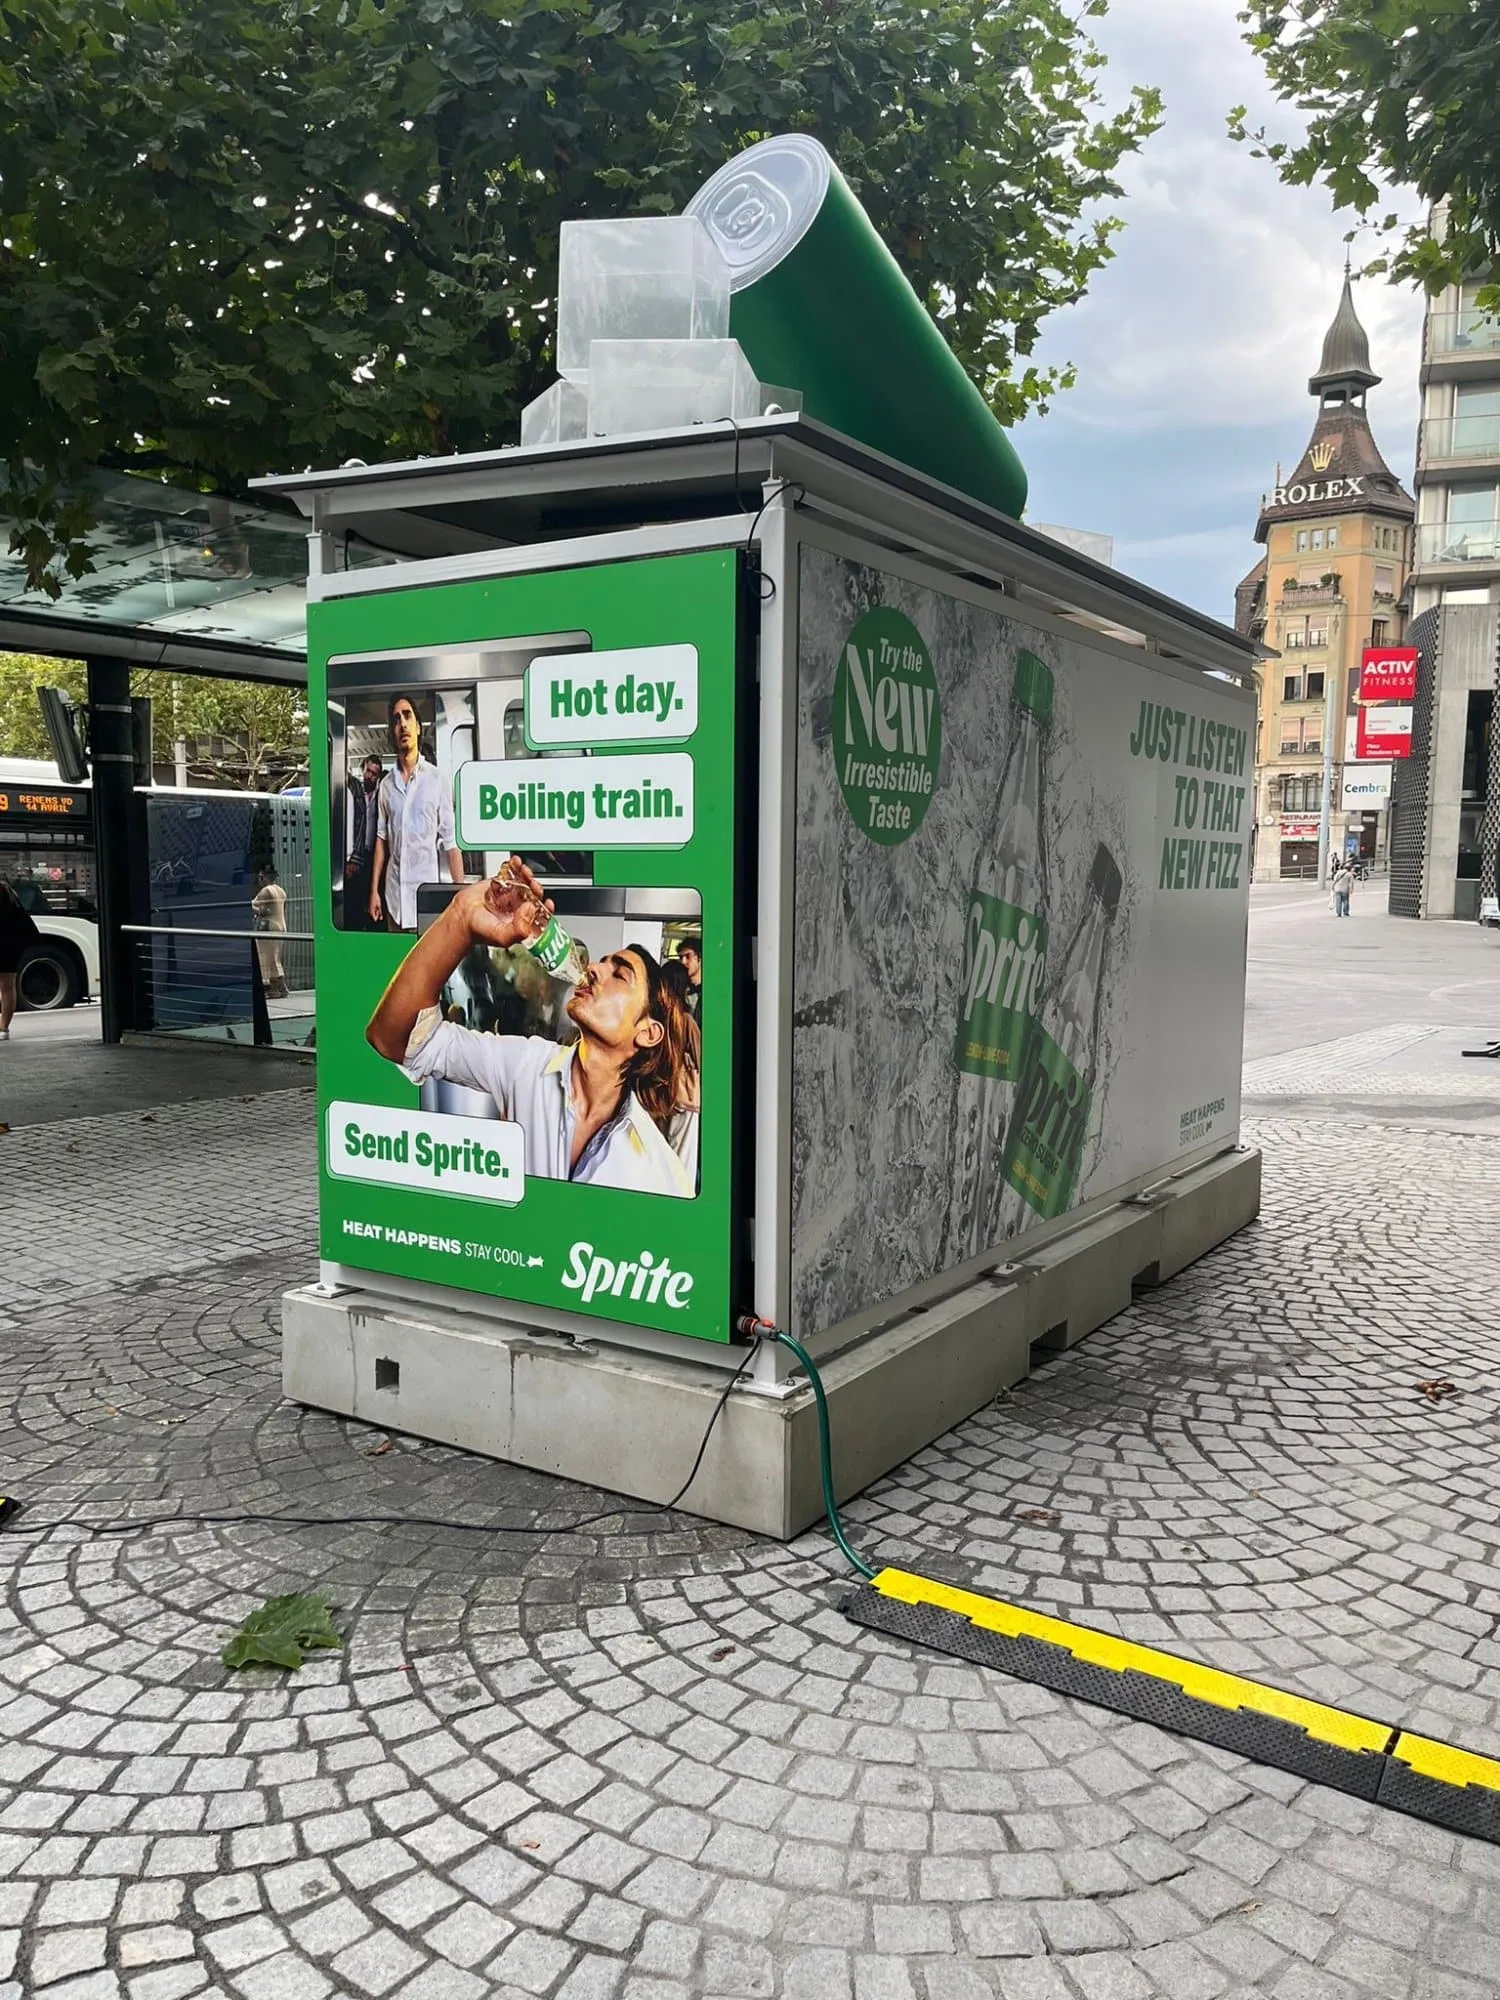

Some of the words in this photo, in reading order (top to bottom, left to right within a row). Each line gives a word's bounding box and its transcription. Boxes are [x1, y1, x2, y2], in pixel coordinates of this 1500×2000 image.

[1271, 477, 1364, 506] ROLEX
[880, 637, 900, 672] Try
[902, 646, 923, 673] the
[1364, 661, 1414, 675] ACTIV
[550, 679, 608, 718] Hot
[615, 675, 683, 722] day.
[845, 643, 934, 756] New
[1362, 677, 1414, 687] FITNESS
[1130, 701, 1186, 763] JUST
[1186, 715, 1247, 776] LISTEN
[844, 753, 933, 795] Irresistible
[1344, 783, 1387, 793] Cembra
[19, 795, 58, 804] RENENS
[41, 804, 69, 812] AVRIL
[479, 783, 585, 829] Boiling
[593, 780, 684, 818] train.
[868, 795, 911, 829] Taste
[1174, 775, 1199, 829] TO
[1202, 780, 1246, 833] THAT
[1159, 837, 1206, 889] NEW
[1206, 841, 1243, 889] FIZZ
[960, 901, 1045, 1022] Sprite
[345, 1122, 409, 1163] Send
[415, 1132, 509, 1179] Sprite.
[343, 1220, 383, 1239] HEAT
[385, 1227, 461, 1254] HAPPENS
[465, 1242, 492, 1260] STAY
[494, 1247, 526, 1267] COOL
[561, 1242, 694, 1309] Sprite
